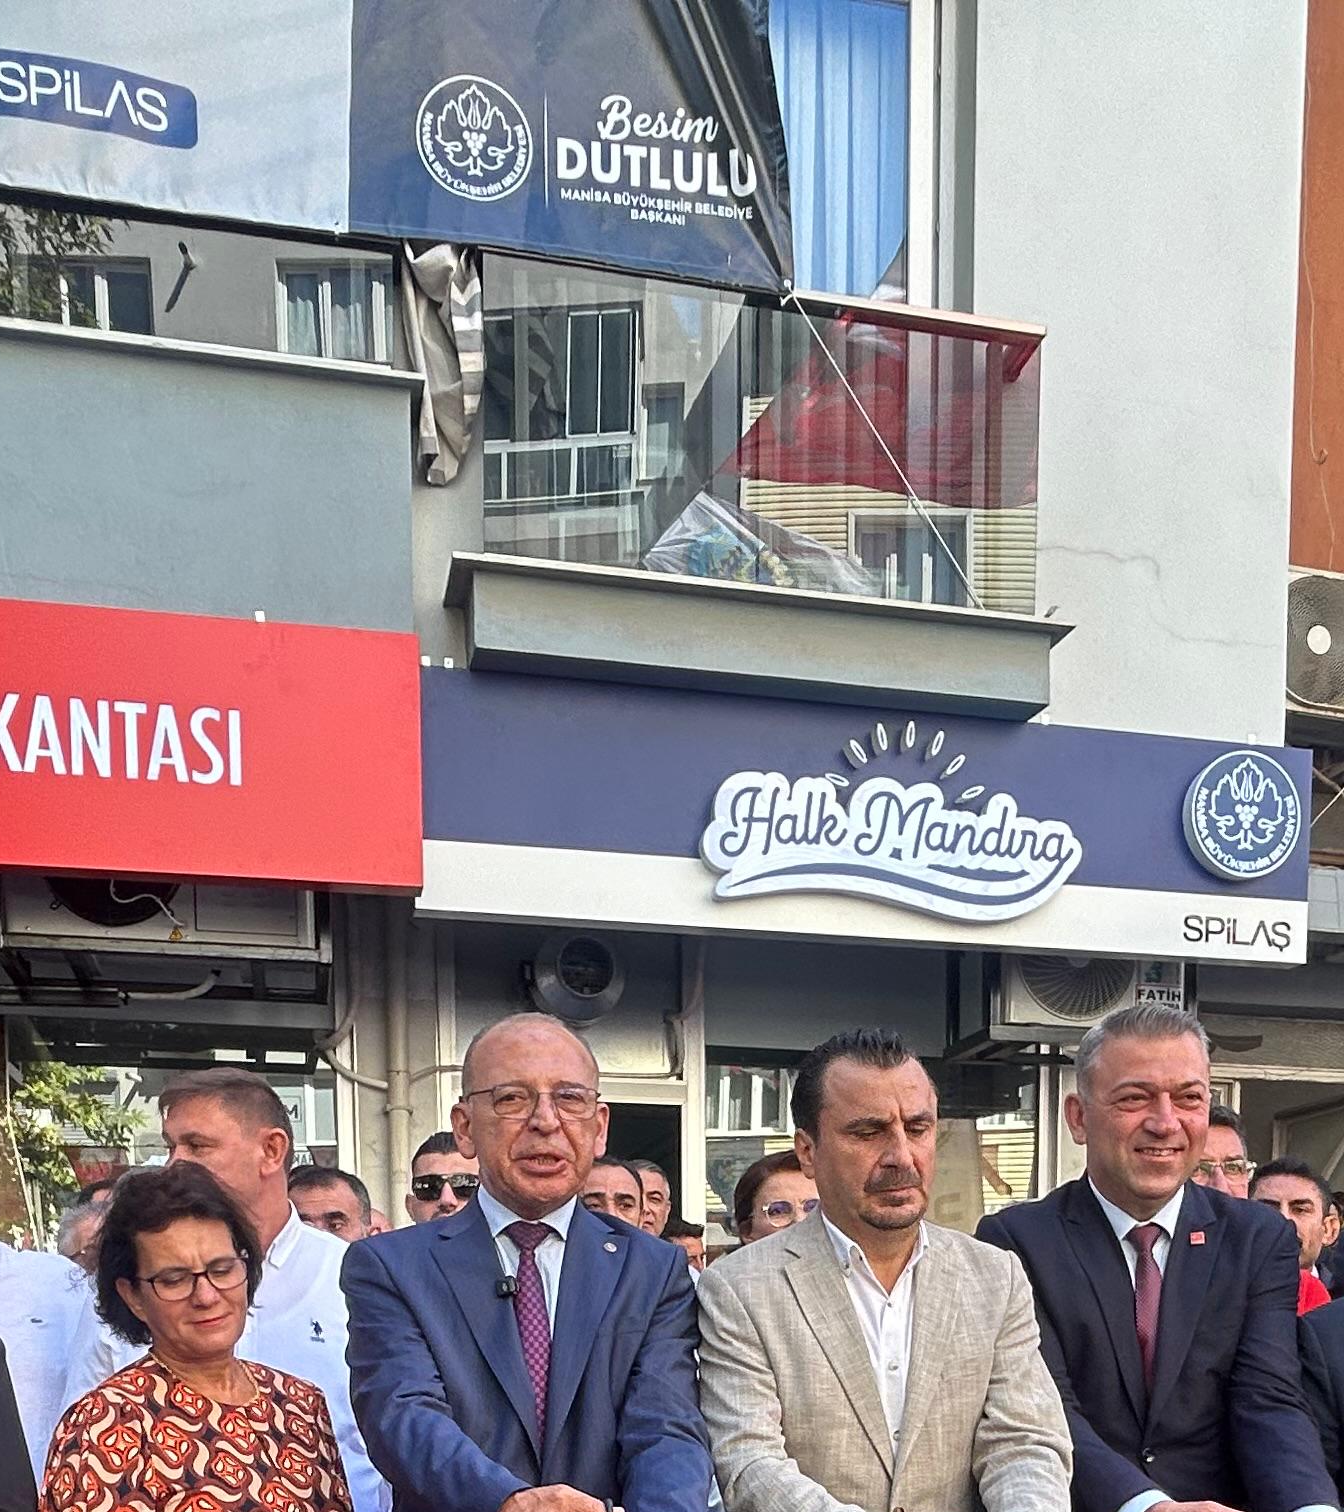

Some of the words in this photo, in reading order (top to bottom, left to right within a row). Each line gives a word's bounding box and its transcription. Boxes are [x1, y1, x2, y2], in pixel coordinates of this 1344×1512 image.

[596, 94, 719, 144] Besim
[556, 137, 757, 197] DUTLULU
[560, 187, 612, 204] MANİSA
[614, 192, 693, 214] BÜYÜKŞEHİR
[694, 203, 753, 221] BELEDİYE
[630, 209, 686, 226] BAŞKANI
[720, 786, 848, 857] Halk
[855, 791, 1074, 864] Mandıra
